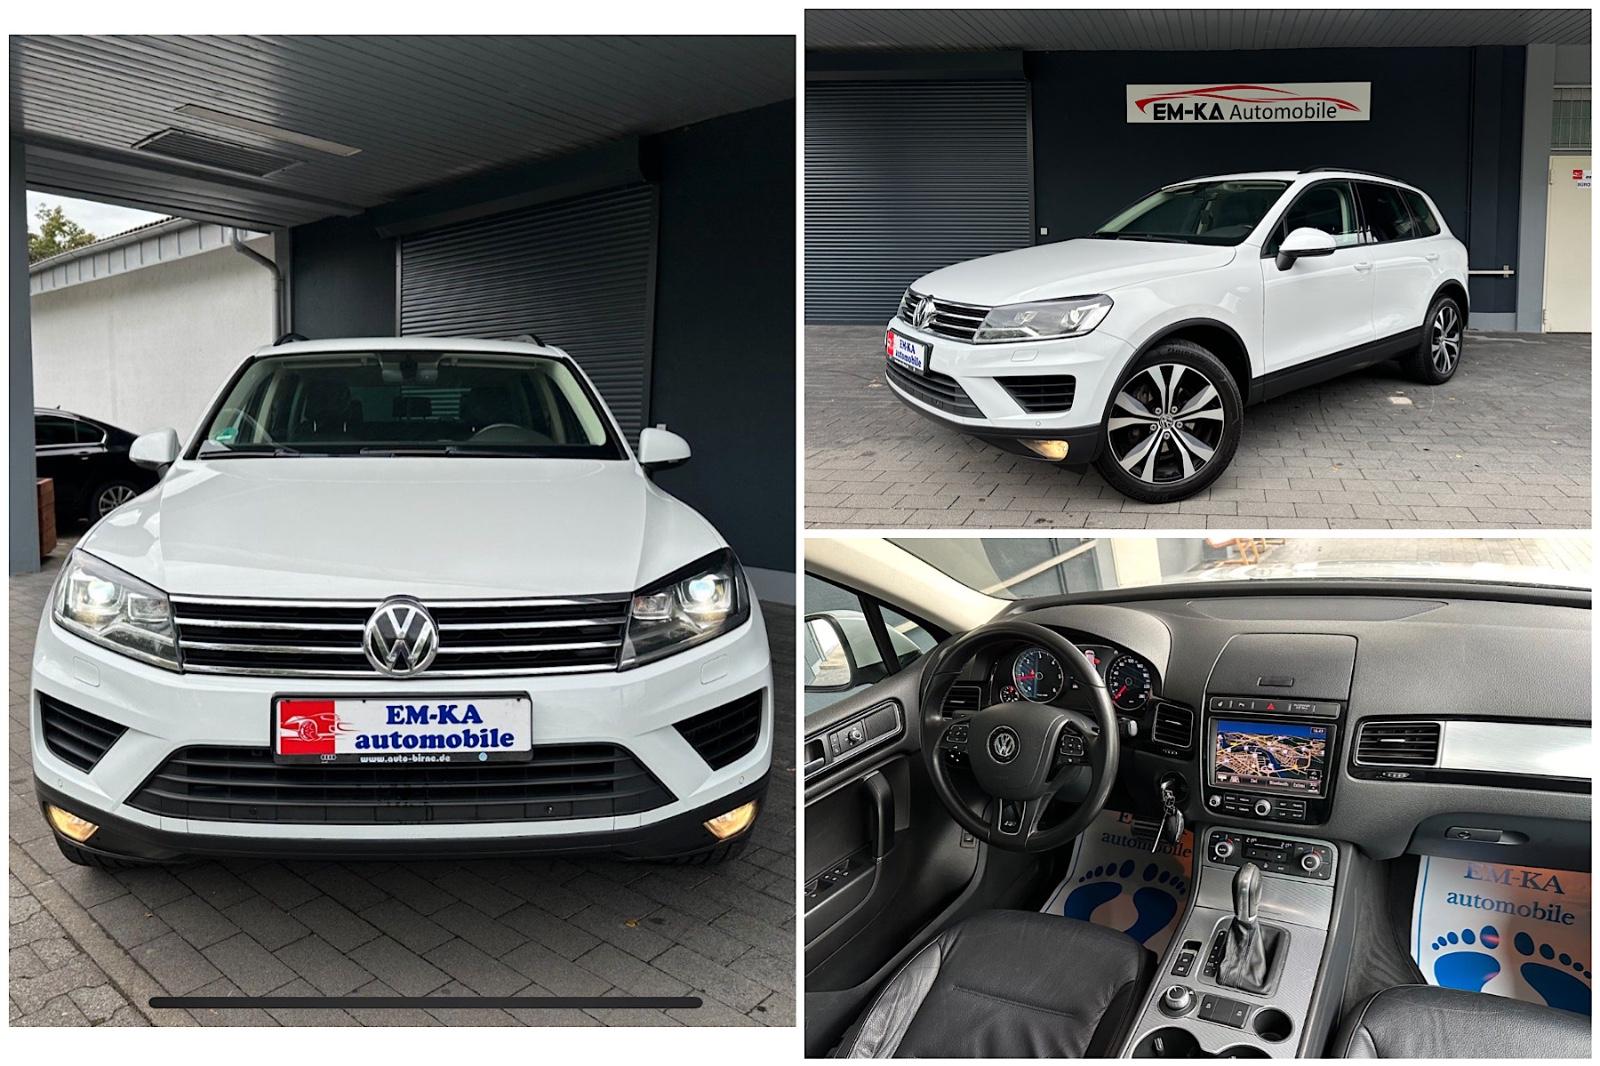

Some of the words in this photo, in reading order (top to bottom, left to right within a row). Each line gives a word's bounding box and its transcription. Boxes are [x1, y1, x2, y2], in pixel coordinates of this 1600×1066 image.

[1153, 102, 1225, 121] EM-KA
[1229, 101, 1337, 121] Automobile
[385, 704, 483, 725] EM-KA
[354, 728, 515, 750] automobile
[359, 753, 451, 763] www.auto-birne.de
[1102, 832, 1192, 858] autombile
[1464, 862, 1566, 895] EM-KA
[1447, 891, 1575, 926] automobile
